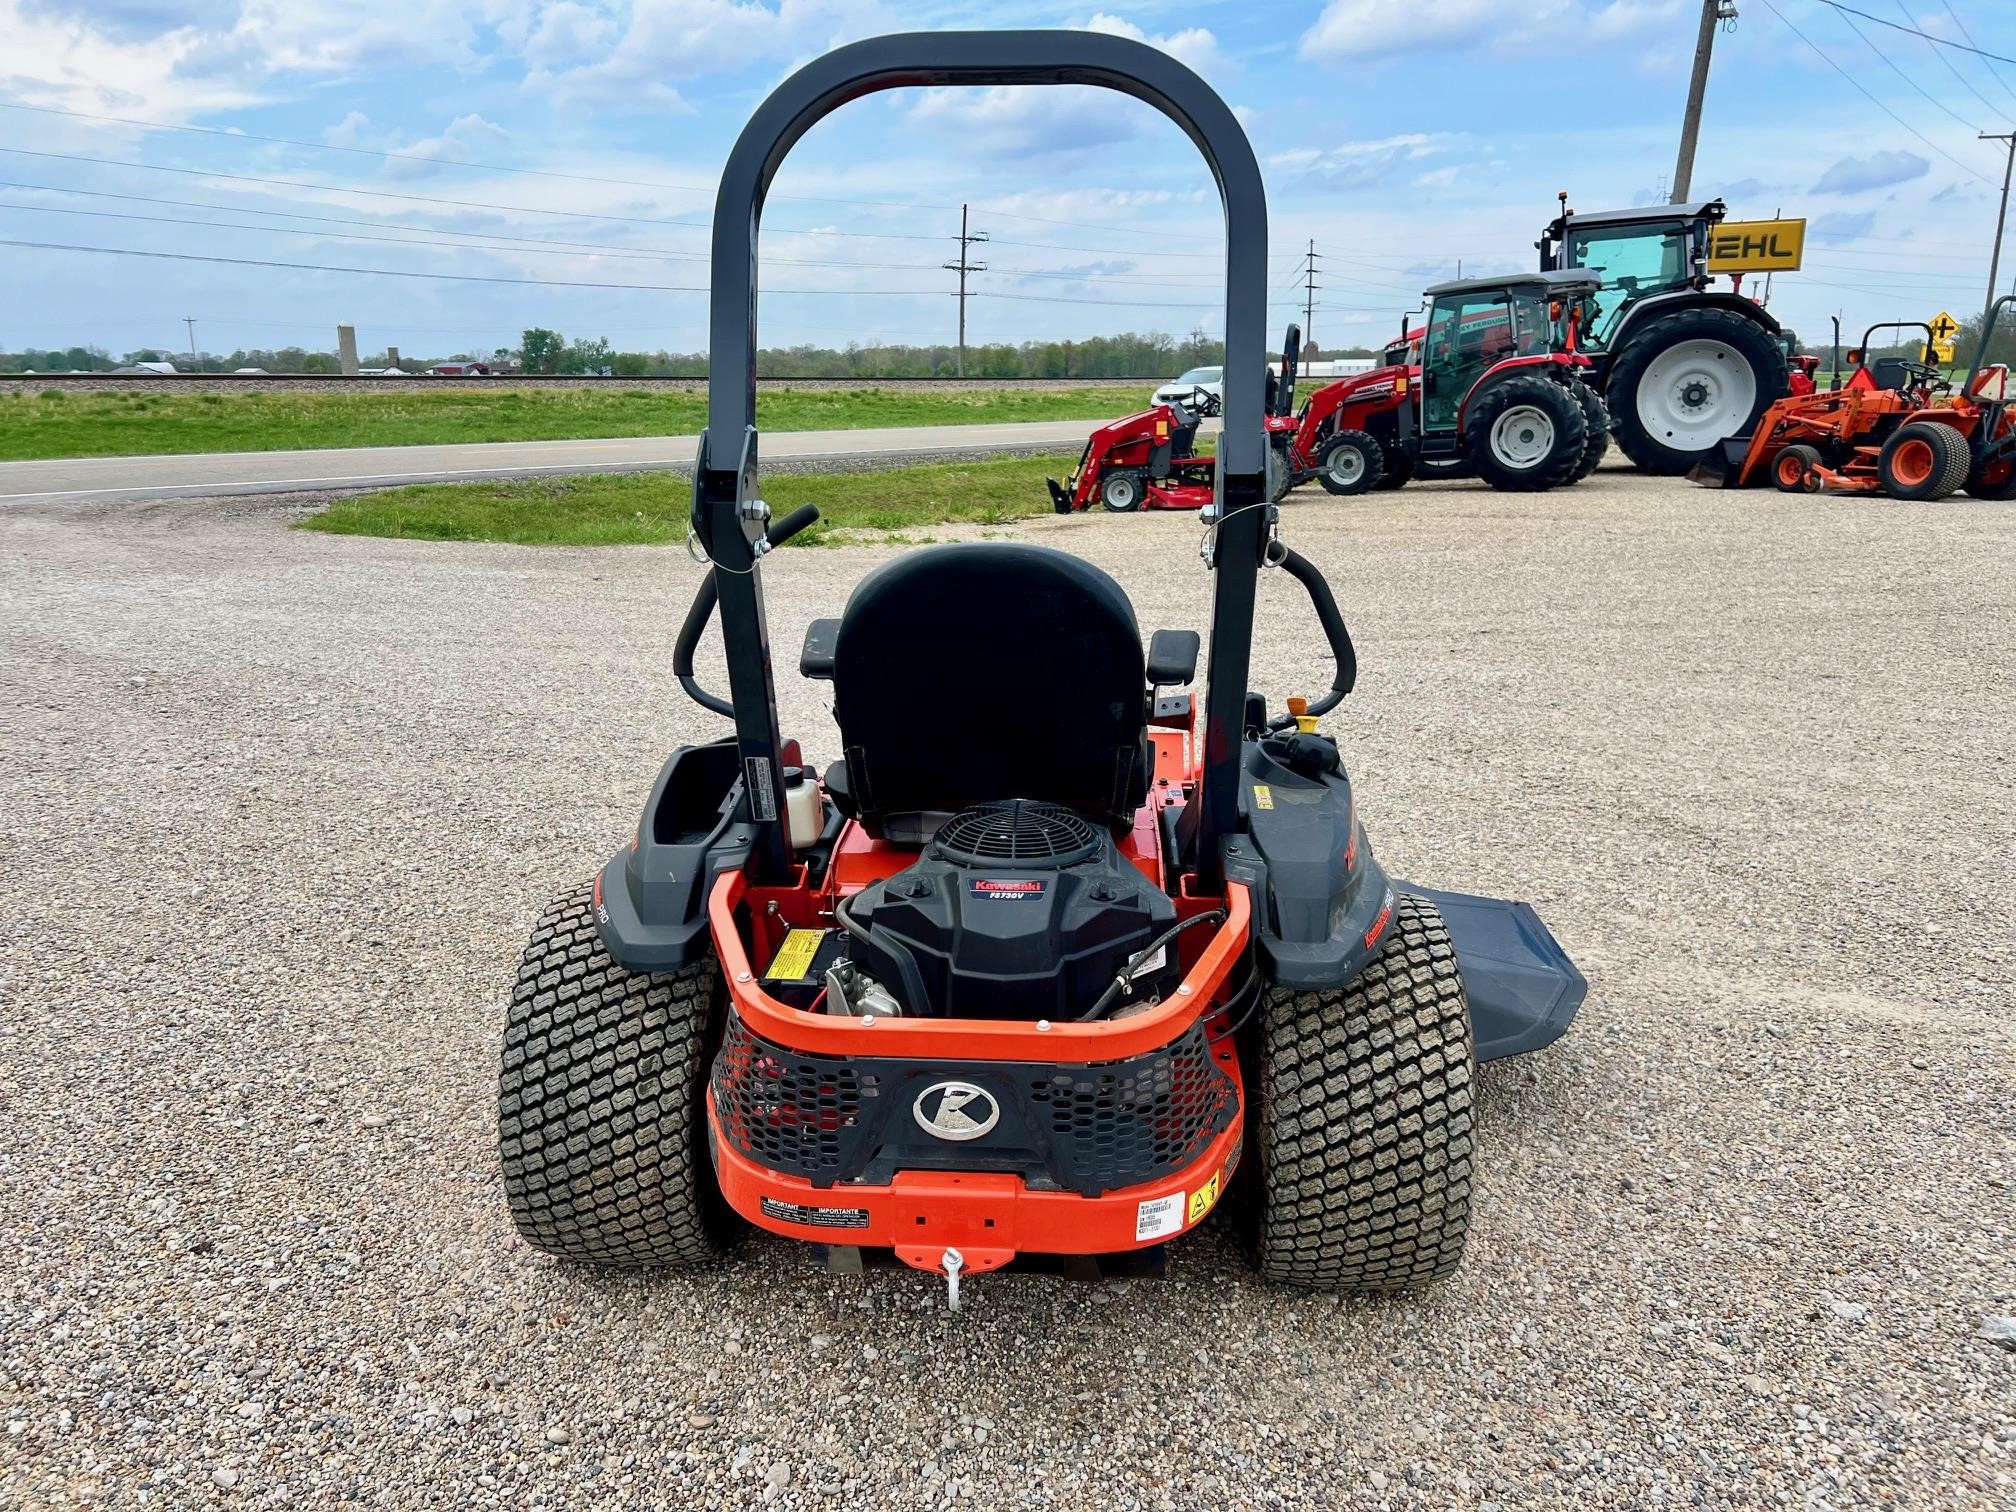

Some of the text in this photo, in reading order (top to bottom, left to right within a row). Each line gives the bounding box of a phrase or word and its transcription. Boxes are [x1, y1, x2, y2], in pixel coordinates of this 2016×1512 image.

[1472, 316, 1509, 328] FERGUSO
[975, 880, 1041, 891] Kawasaki
[597, 903, 610, 924] PRO
[766, 1198, 799, 1210] IMPORTANT
